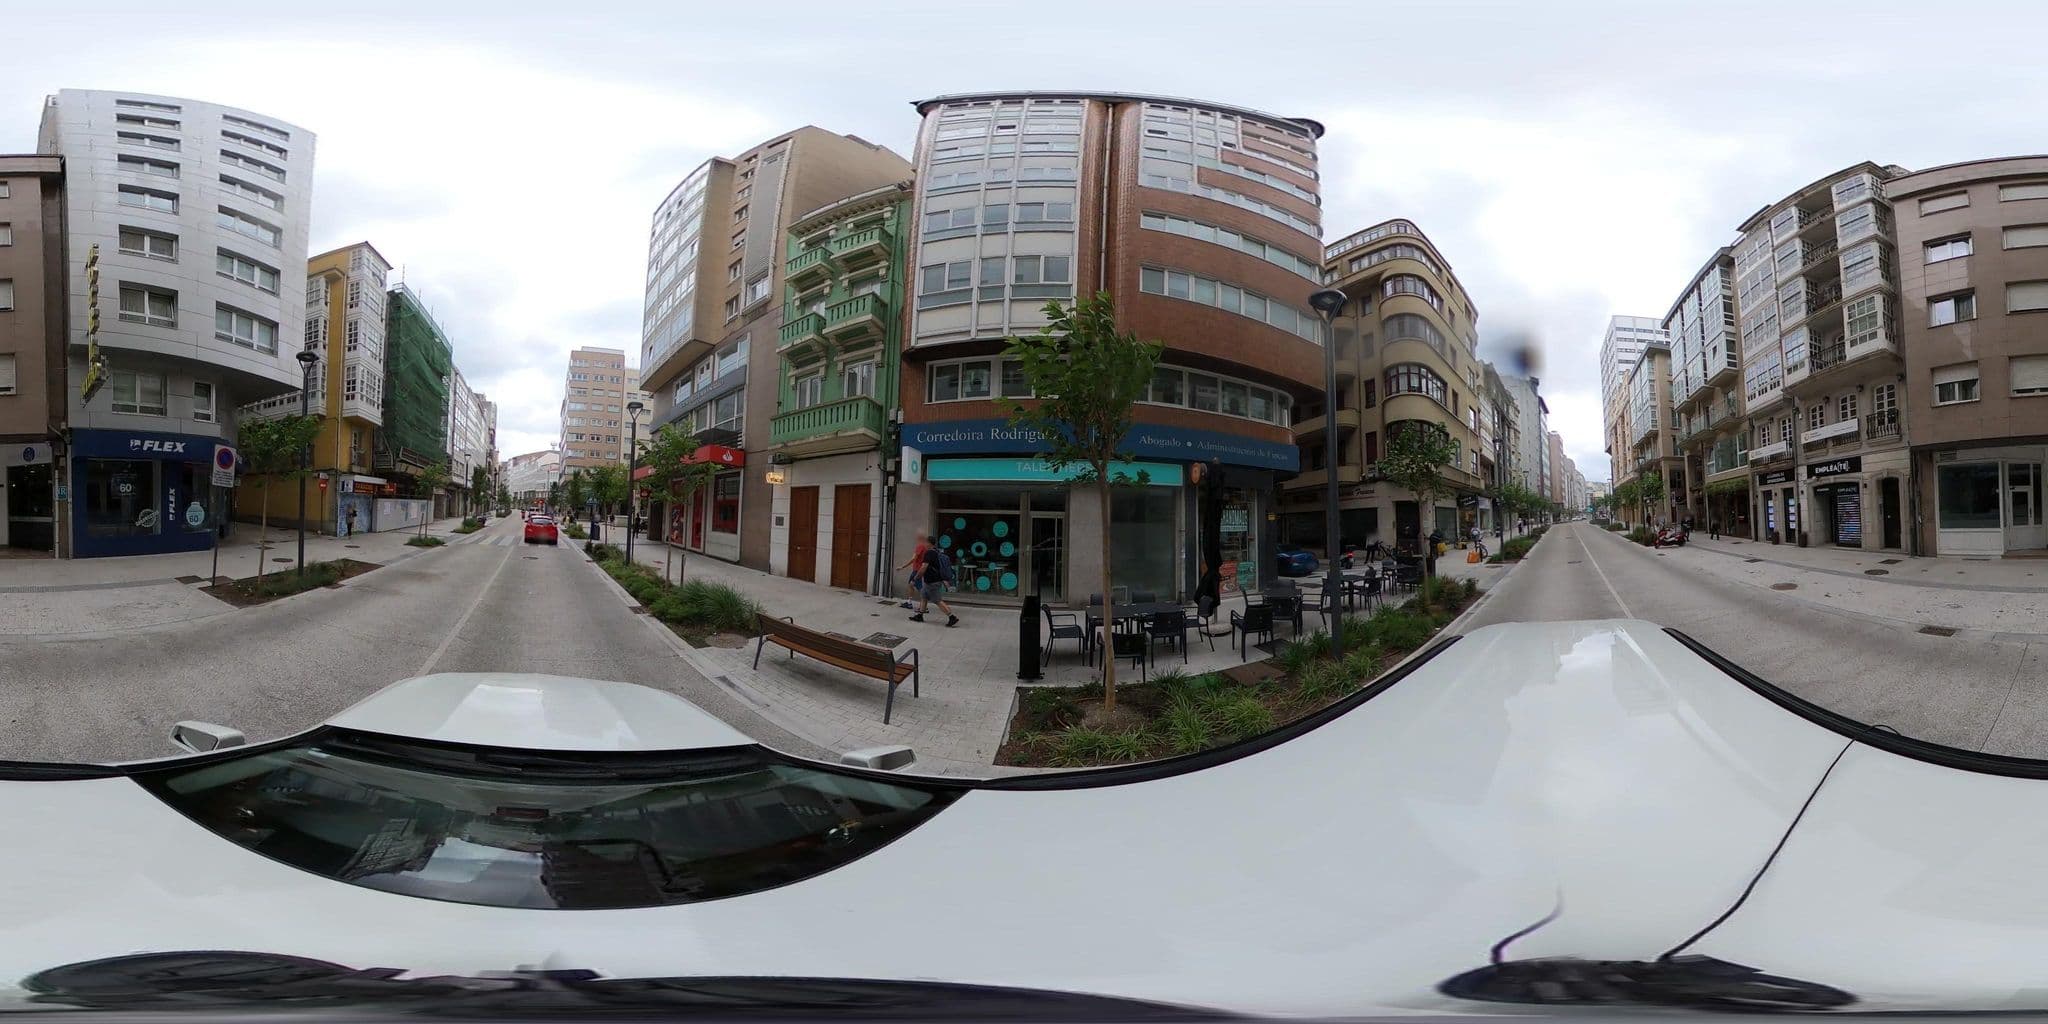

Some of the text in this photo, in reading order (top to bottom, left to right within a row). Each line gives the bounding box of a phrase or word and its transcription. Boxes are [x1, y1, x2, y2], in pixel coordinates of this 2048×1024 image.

[917, 429, 984, 443] Corredoira
[1139, 435, 1182, 448] Abogado
[143, 440, 187, 453] FLEX
